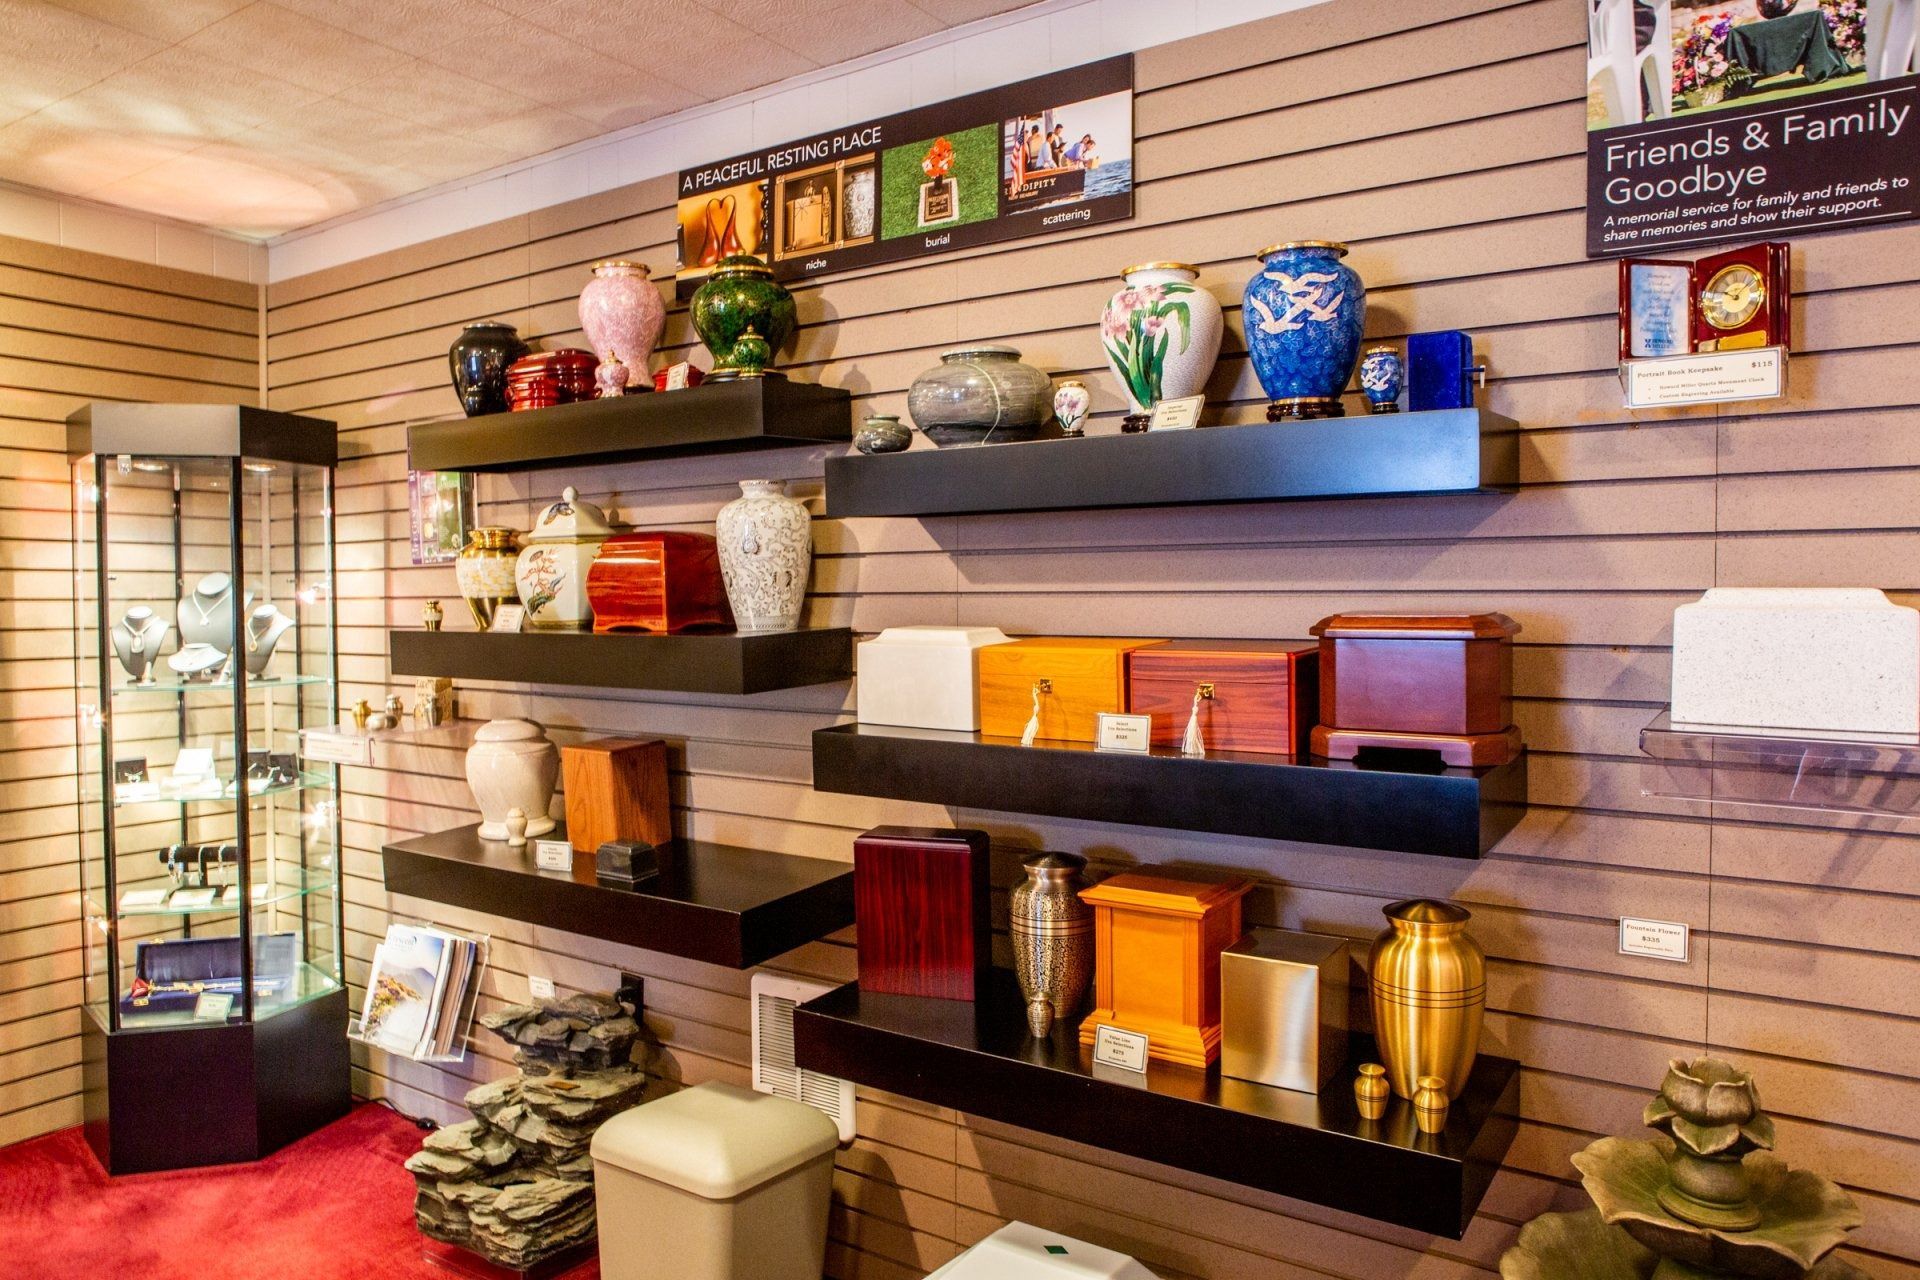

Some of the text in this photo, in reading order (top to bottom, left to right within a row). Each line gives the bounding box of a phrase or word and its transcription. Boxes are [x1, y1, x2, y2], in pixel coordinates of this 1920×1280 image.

[1607, 98, 1911, 172] Friends & Family
[682, 126, 882, 192] A PEACEFUL RESTING PLACE
[1605, 163, 1768, 205] Goodbye
[1603, 177, 1909, 227] A memorial service for family and friends to
[1042, 208, 1091, 226] scattering
[1603, 196, 1882, 243] share memories and show their support.
[925, 232, 950, 248] burial
[805, 258, 827, 271] niche
[1637, 371, 1665, 379] Portrait
[1687, 365, 1723, 374] Keepsake
[1751, 360, 1773, 369] $115
[1626, 924, 1681, 936] Fountain Flower
